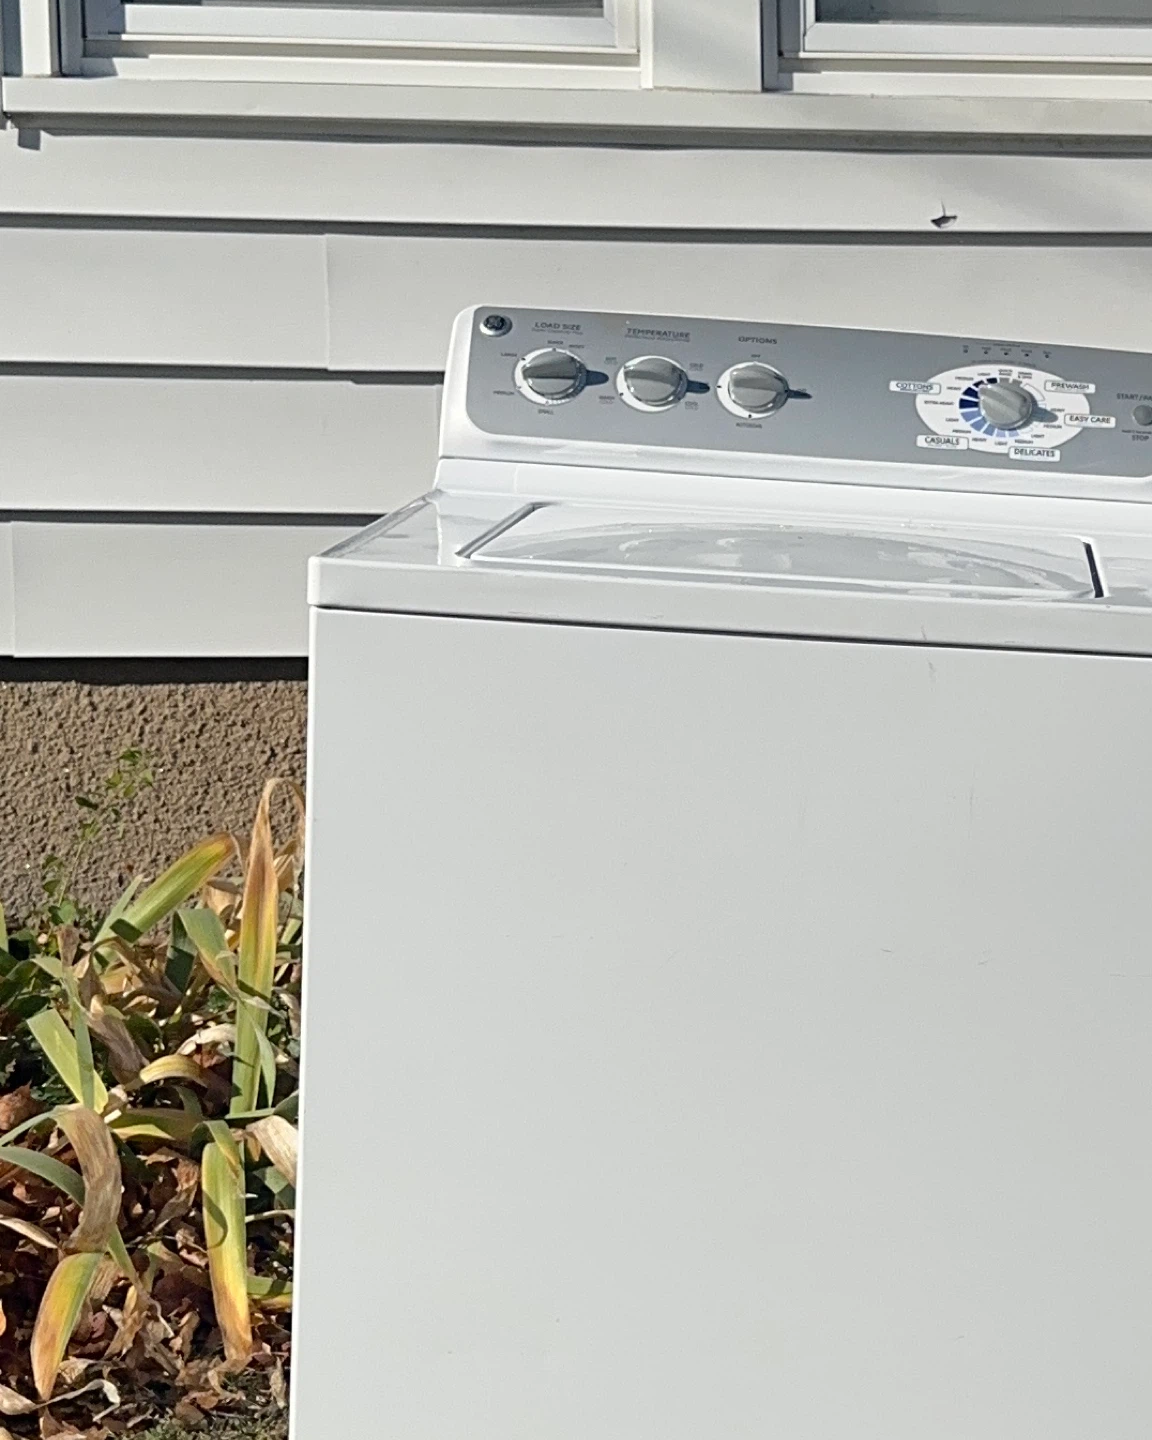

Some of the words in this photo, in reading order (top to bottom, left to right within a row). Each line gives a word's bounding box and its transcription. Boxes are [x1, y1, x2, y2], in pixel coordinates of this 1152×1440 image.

[627, 328, 691, 338] TEMPERATURE
[738, 335, 778, 345] OPTIONS
[1051, 382, 1090, 390] PREWASH
[924, 437, 960, 446] CASUALS
[1014, 448, 1056, 457] DELICATES
